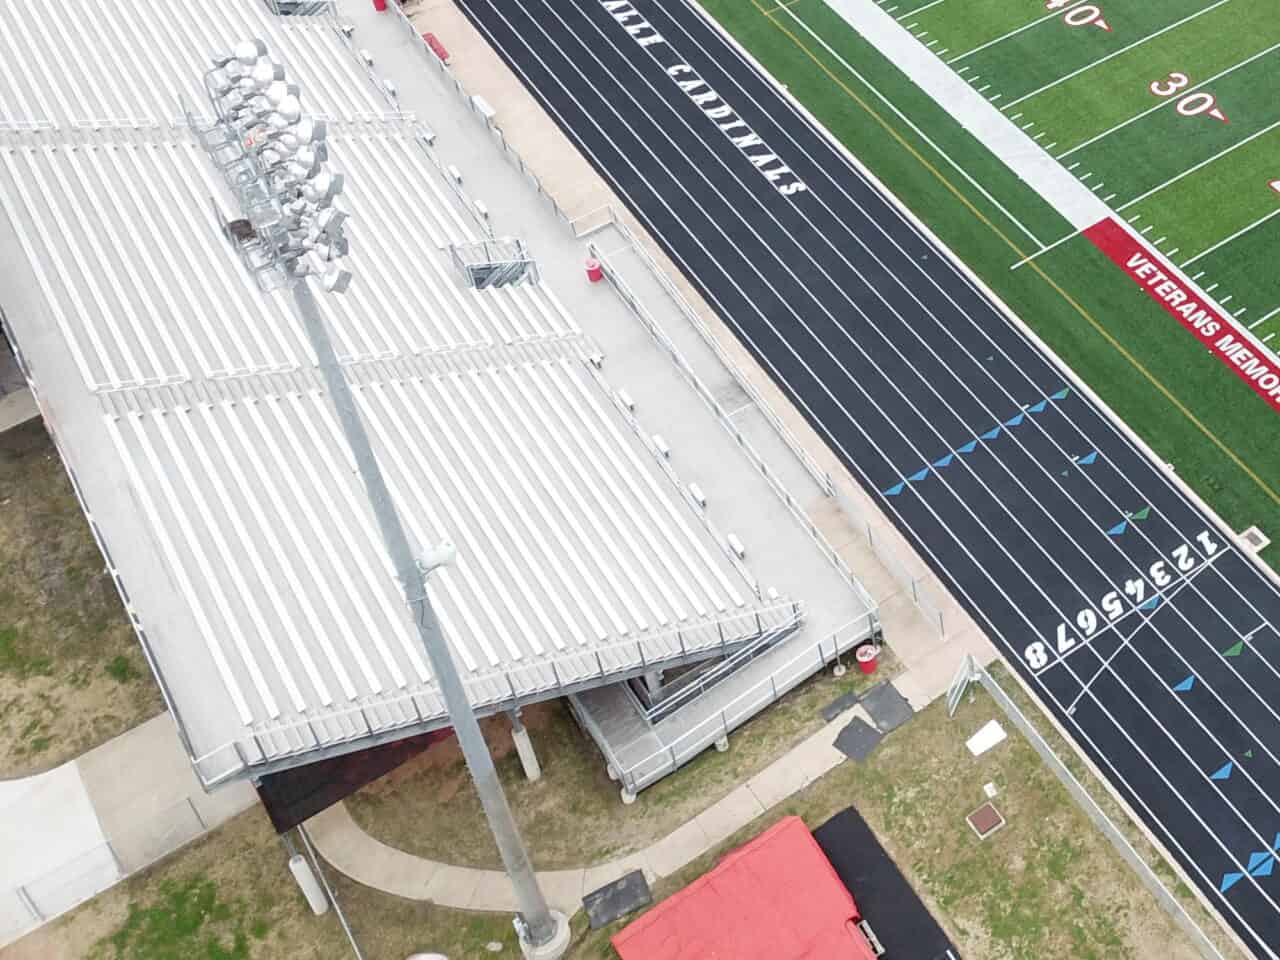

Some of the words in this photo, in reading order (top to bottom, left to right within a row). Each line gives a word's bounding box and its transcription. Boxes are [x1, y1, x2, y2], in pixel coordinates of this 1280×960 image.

[1150, 72, 1215, 116] 30
[667, 63, 808, 196] CARDINALS
[1125, 252, 1221, 337] VETERANS
[1196, 530, 1218, 555] 1
[1171, 544, 1195, 571] 2
[1150, 561, 1171, 587] 3
[1124, 578, 1145, 603] 4
[1101, 591, 1124, 621] 5
[1076, 608, 1097, 636] 6
[1056, 623, 1076, 654] 7
[1024, 641, 1048, 669] 8
